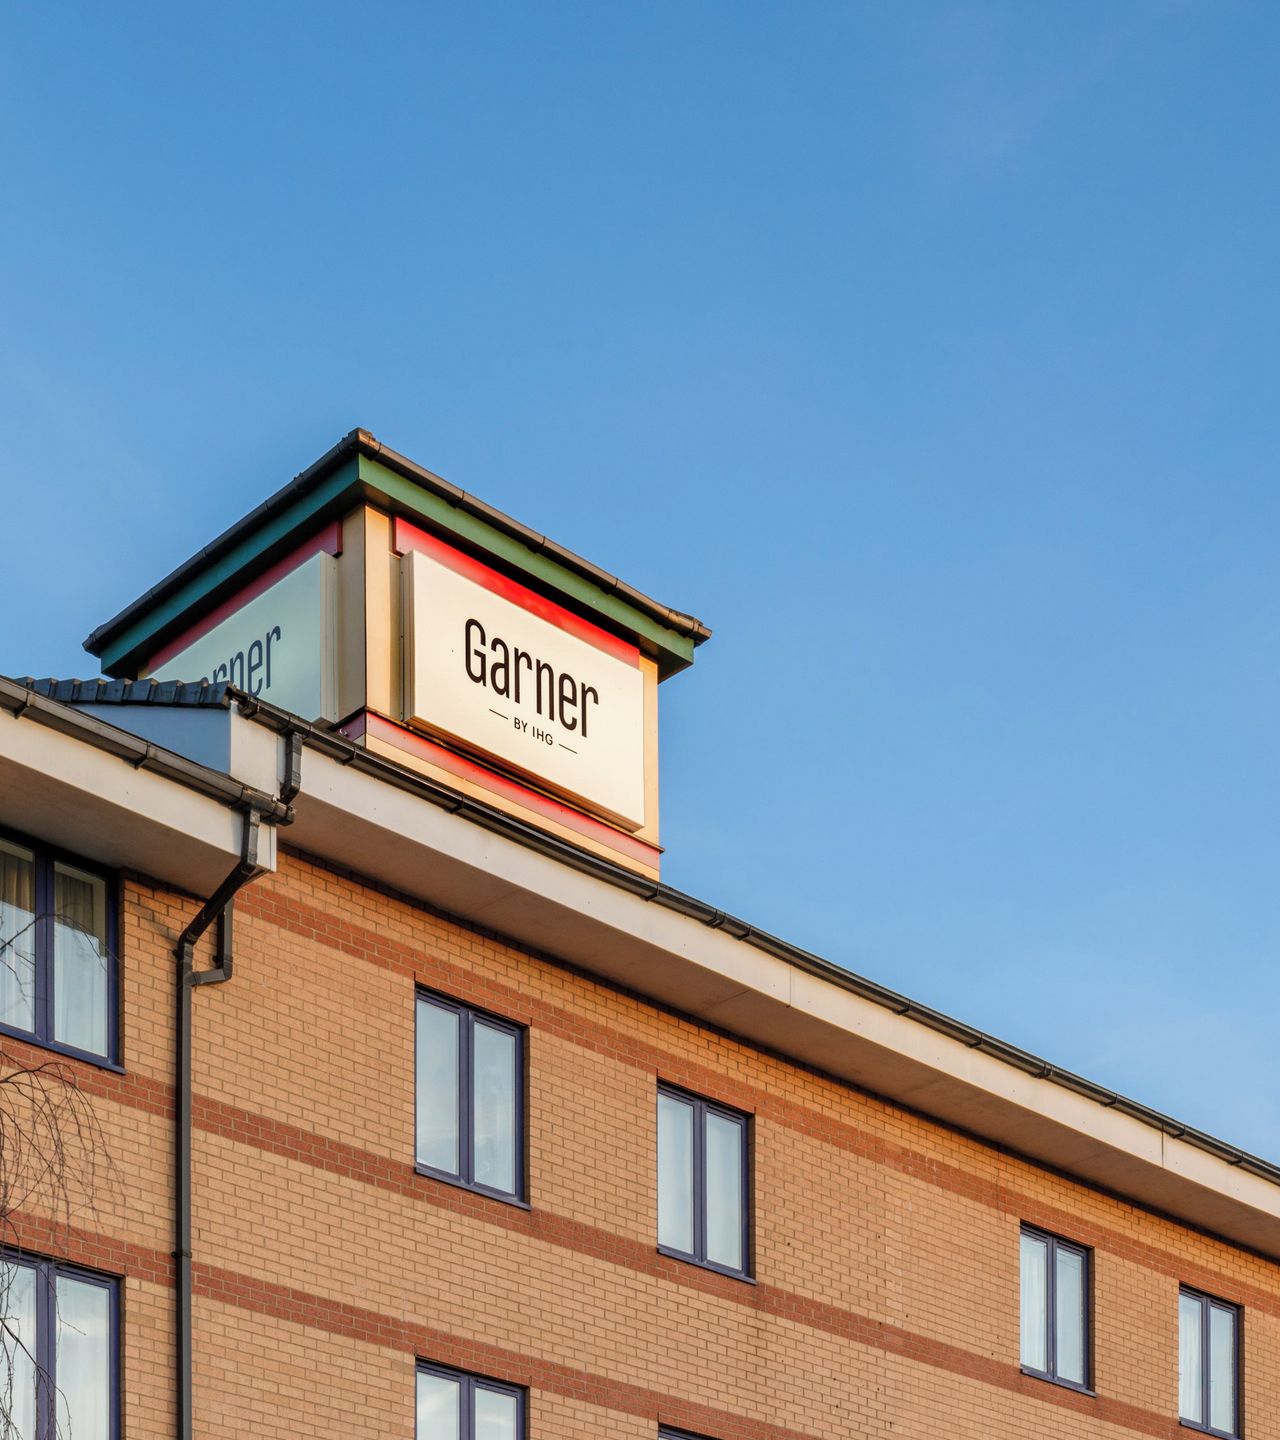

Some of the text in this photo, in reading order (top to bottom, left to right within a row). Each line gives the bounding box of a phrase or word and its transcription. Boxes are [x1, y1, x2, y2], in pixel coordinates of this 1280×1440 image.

[200, 625, 281, 697] rner
[465, 618, 599, 738] Garner
[514, 717, 554, 746] BY IHG
